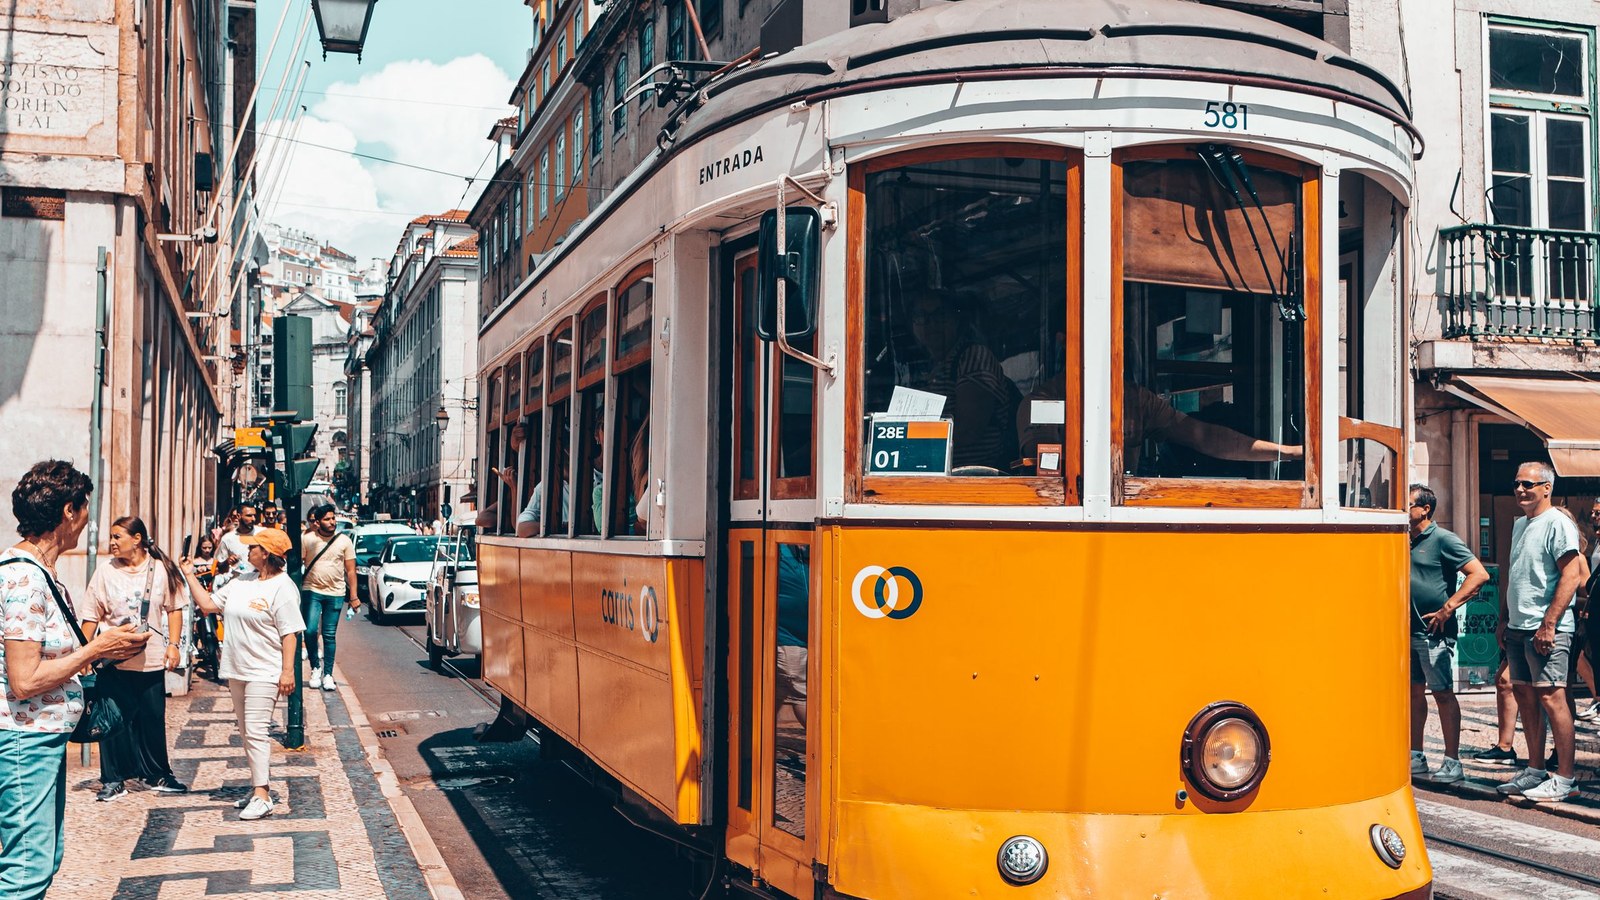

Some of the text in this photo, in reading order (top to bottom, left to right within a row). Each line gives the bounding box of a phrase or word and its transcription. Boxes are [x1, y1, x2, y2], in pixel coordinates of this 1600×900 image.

[1204, 101, 1248, 131] 581
[699, 145, 764, 186] ENTRADA
[877, 426, 905, 439] 28E
[874, 450, 900, 469] 01
[602, 577, 634, 631] carris
